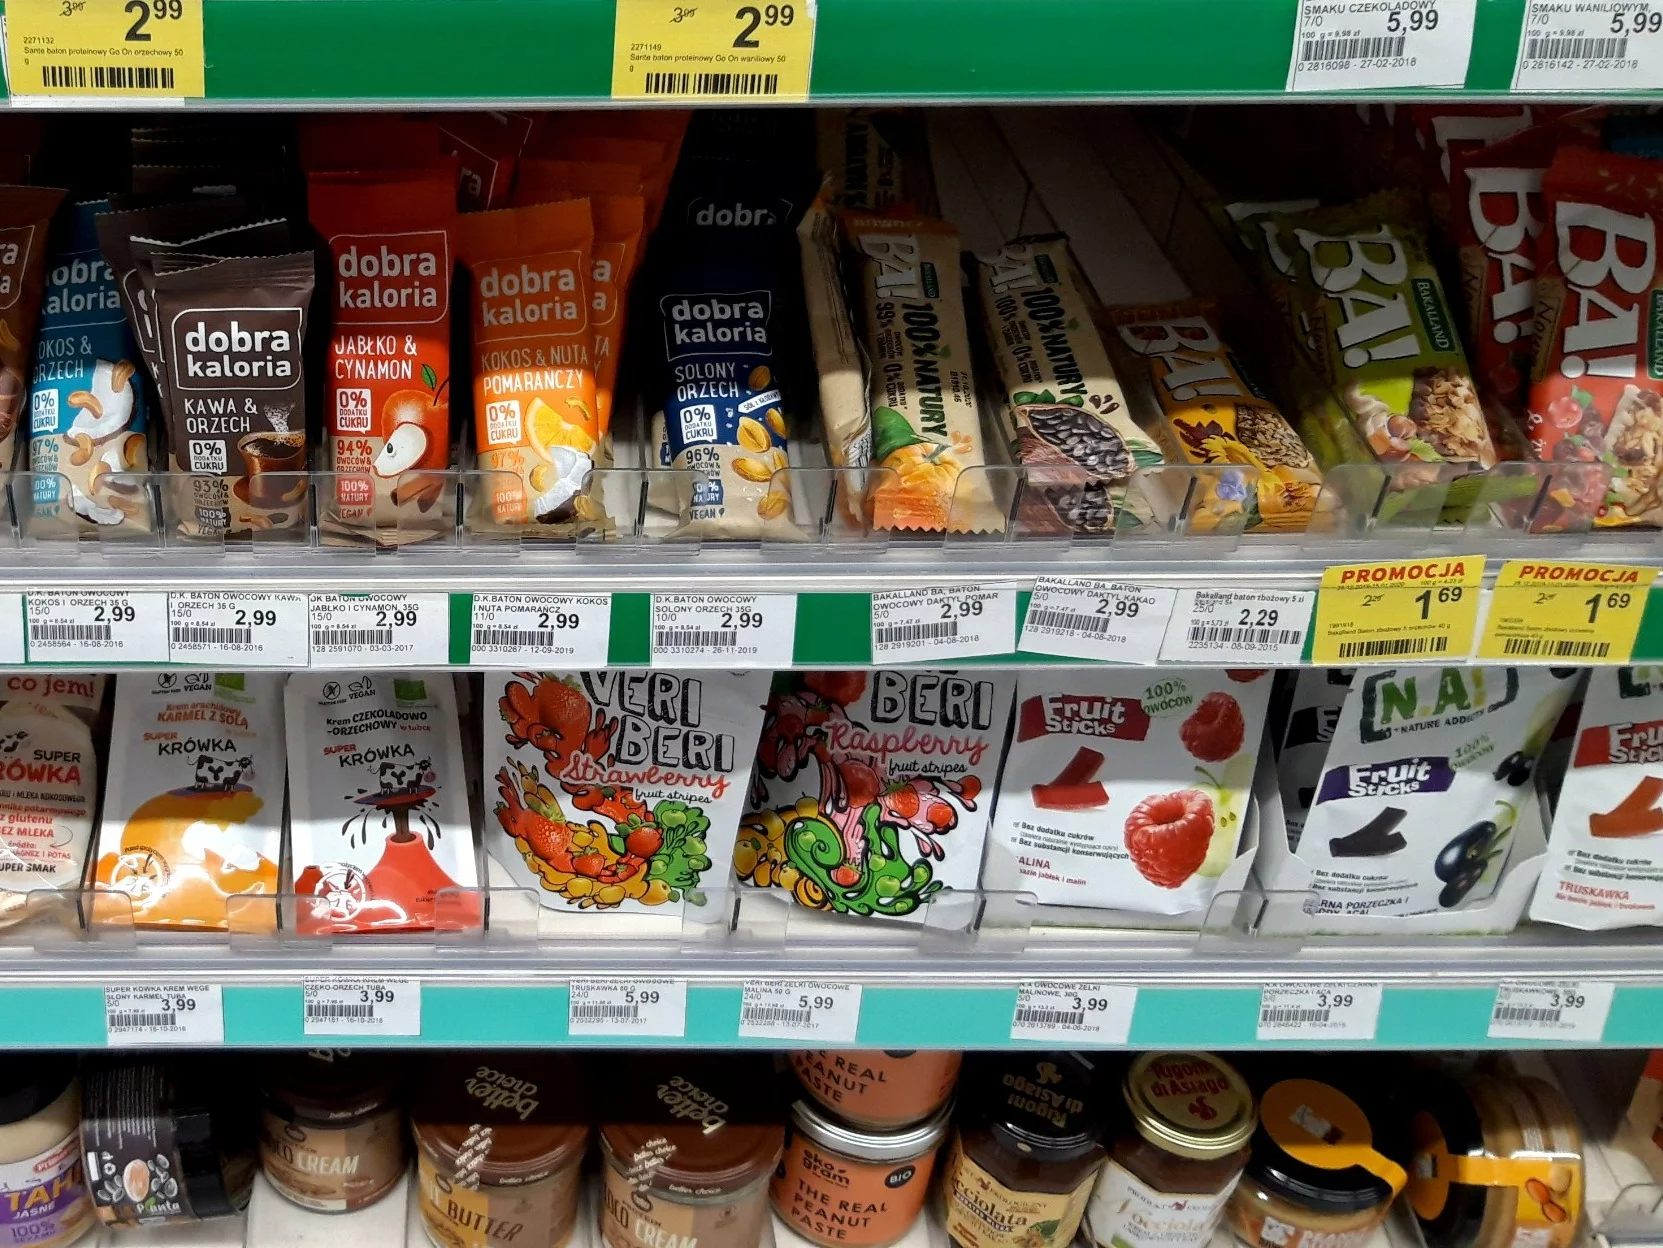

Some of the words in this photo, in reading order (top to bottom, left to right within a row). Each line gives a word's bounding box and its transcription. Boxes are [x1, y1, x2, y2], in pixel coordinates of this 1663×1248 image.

[1304, 5, 1346, 16] SMAKU
[1348, 1, 1437, 13] CZEKOLADOWY
[1531, 4, 1573, 14] SMAKU
[1386, 10, 1440, 36] 5,99
[1609, 13, 1663, 38] 5,99
[23, 36, 55, 45] 2271132
[630, 42, 662, 51] 2271149
[23, 47, 45, 55] Sante
[46, 48, 67, 56] baton
[68, 47, 108, 57] proteinowy
[133, 48, 174, 57] orzechowy
[652, 54, 673, 62] baton
[674, 54, 714, 63] proteinowy
[338, 246, 437, 287] dobra
[479, 262, 577, 298] dobra
[339, 282, 438, 310] kaloria
[1293, 220, 1422, 370] BA!
[1555, 201, 1657, 379] BA!
[482, 296, 579, 327] kaloria
[671, 299, 765, 322] dobra
[674, 319, 768, 347] kaloria
[184, 323, 291, 363] dobra
[335, 336, 397, 357] JABŁKO
[482, 347, 532, 372] KOKOS
[551, 344, 589, 365] NUTA
[187, 359, 292, 387] kaloria
[335, 359, 412, 380] CYNAMON
[674, 362, 736, 382] SOLONY
[483, 368, 584, 397] POMARAŃCZY
[339, 390, 369, 409] 0%
[677, 381, 740, 403] ORZECH
[184, 398, 238, 416] KAWA
[489, 403, 517, 421] 0%
[684, 406, 711, 424] 0%
[186, 416, 251, 434] ORZECH
[339, 417, 370, 429] CUKRU
[490, 428, 519, 441] CUKRU
[685, 428, 714, 441] CUKRU
[193, 441, 222, 456] 0%
[337, 439, 373, 457] 94%
[685, 446, 720, 465] 96%
[195, 461, 224, 471] CUKRU
[1341, 561, 1466, 583] PROMOCJA
[1518, 565, 1640, 583] PROMOCJA
[1038, 576, 1093, 590] BAKALLAND
[28, 598, 60, 606] KOKOS
[70, 598, 107, 606] ORZECH
[222, 592, 272, 601] OWOCOWY
[524, 595, 575, 604] OWOCOWY
[575, 597, 609, 606] KOKOS
[706, 596, 757, 604] OWOCOWY
[873, 589, 930, 602] BAKALLAND
[873, 600, 925, 611] OWOCOWY
[926, 596, 963, 606] DAKTYL
[964, 592, 1000, 602] POMAR
[1034, 585, 1086, 600] OWOCOWY
[1086, 590, 1122, 602] DAKTYL
[1122, 594, 1156, 606] KAKAO
[1195, 591, 1233, 601] Bakalland
[1233, 592, 1255, 601] baton
[1254, 593, 1290, 604] zbożowy
[93, 605, 136, 625] 2,99
[655, 605, 693, 613] SOLONY
[694, 605, 734, 613] ORZECH
[940, 600, 984, 622] 2,99
[1094, 597, 1140, 620] 2,99
[234, 609, 277, 628] 2,99
[375, 611, 418, 630] 2,99
[537, 612, 580, 631] 2,99
[720, 612, 764, 632] 2,99
[1237, 608, 1279, 629] 2,29
[328, 644, 363, 653] 2591070
[368, 644, 414, 653] 03-03-2017
[670, 646, 705, 655] 3310274
[712, 646, 758, 655] 26-11-2019
[890, 641, 927, 651] 2919201
[1187, 641, 1224, 651] 2235134
[1230, 643, 1280, 653] 08-09-2015
[7, 678, 38, 692] co
[42, 674, 96, 698] jem!
[184, 683, 213, 692] VEGAN
[348, 689, 376, 701] VEGAN
[1145, 680, 1188, 700] 100%
[577, 670, 703, 729] VERI
[870, 670, 995, 731] BERI
[157, 710, 207, 724] KARMEL
[351, 708, 429, 723] CZEKOLADOWO
[1041, 693, 1127, 725] Fruit
[326, 722, 398, 738] -ORZECHOWY
[1044, 718, 1117, 736] Sticks
[1401, 719, 1441, 735] NATURE
[143, 732, 178, 741] SUPER
[614, 714, 736, 773] BERI
[158, 738, 238, 757] KRÓWKA
[323, 744, 358, 756] SUPER
[826, 724, 990, 768] Raspberry
[33, 749, 81, 763] SUPER
[338, 744, 416, 769] KRÓWKA
[562, 752, 732, 800] Strawberry
[888, 758, 920, 775] fruit
[920, 761, 969, 778] stripes
[1347, 758, 1432, 785] Fruit
[635, 788, 667, 802] fruit
[666, 790, 714, 806] stripes
[1347, 780, 1421, 798] Sticks
[8, 813, 53, 825] glutenu
[17, 828, 55, 839] MLEKA
[1036, 825, 1067, 838] dodatku
[1067, 831, 1096, 842] cukrów
[1072, 847, 1130, 861] konserwujących
[26, 863, 57, 874] SMAK
[1558, 880, 1631, 902] TRUSKAWKA
[1346, 897, 1404, 911] PORZECZKA
[304, 983, 366, 992] CZEKO-ORZECH
[571, 984, 619, 993] TRUSKAWKA
[360, 990, 395, 1006] 3,99
[624, 991, 661, 1005] 5,99
[798, 995, 834, 1011] 5,99
[1071, 996, 1109, 1013] 3,99
[1317, 994, 1354, 1009] 3,99
[1550, 994, 1586, 1009] 3,99
[161, 999, 197, 1016] 3,99
[835, 1059, 888, 1084] REAL
[1166, 1076, 1230, 1096] Asiago
[296, 1154, 361, 1178] CREAM
[804, 1150, 834, 1172] eko
[803, 1162, 850, 1190] gram
[888, 1170, 914, 1186] BIO
[797, 1180, 834, 1205] THE
[838, 1197, 890, 1222] REAL
[12, 1202, 57, 1220] JASNE
[795, 1198, 873, 1232] PEANUT
[447, 1199, 524, 1243] BUTTER
[791, 1208, 848, 1241] PASTE
